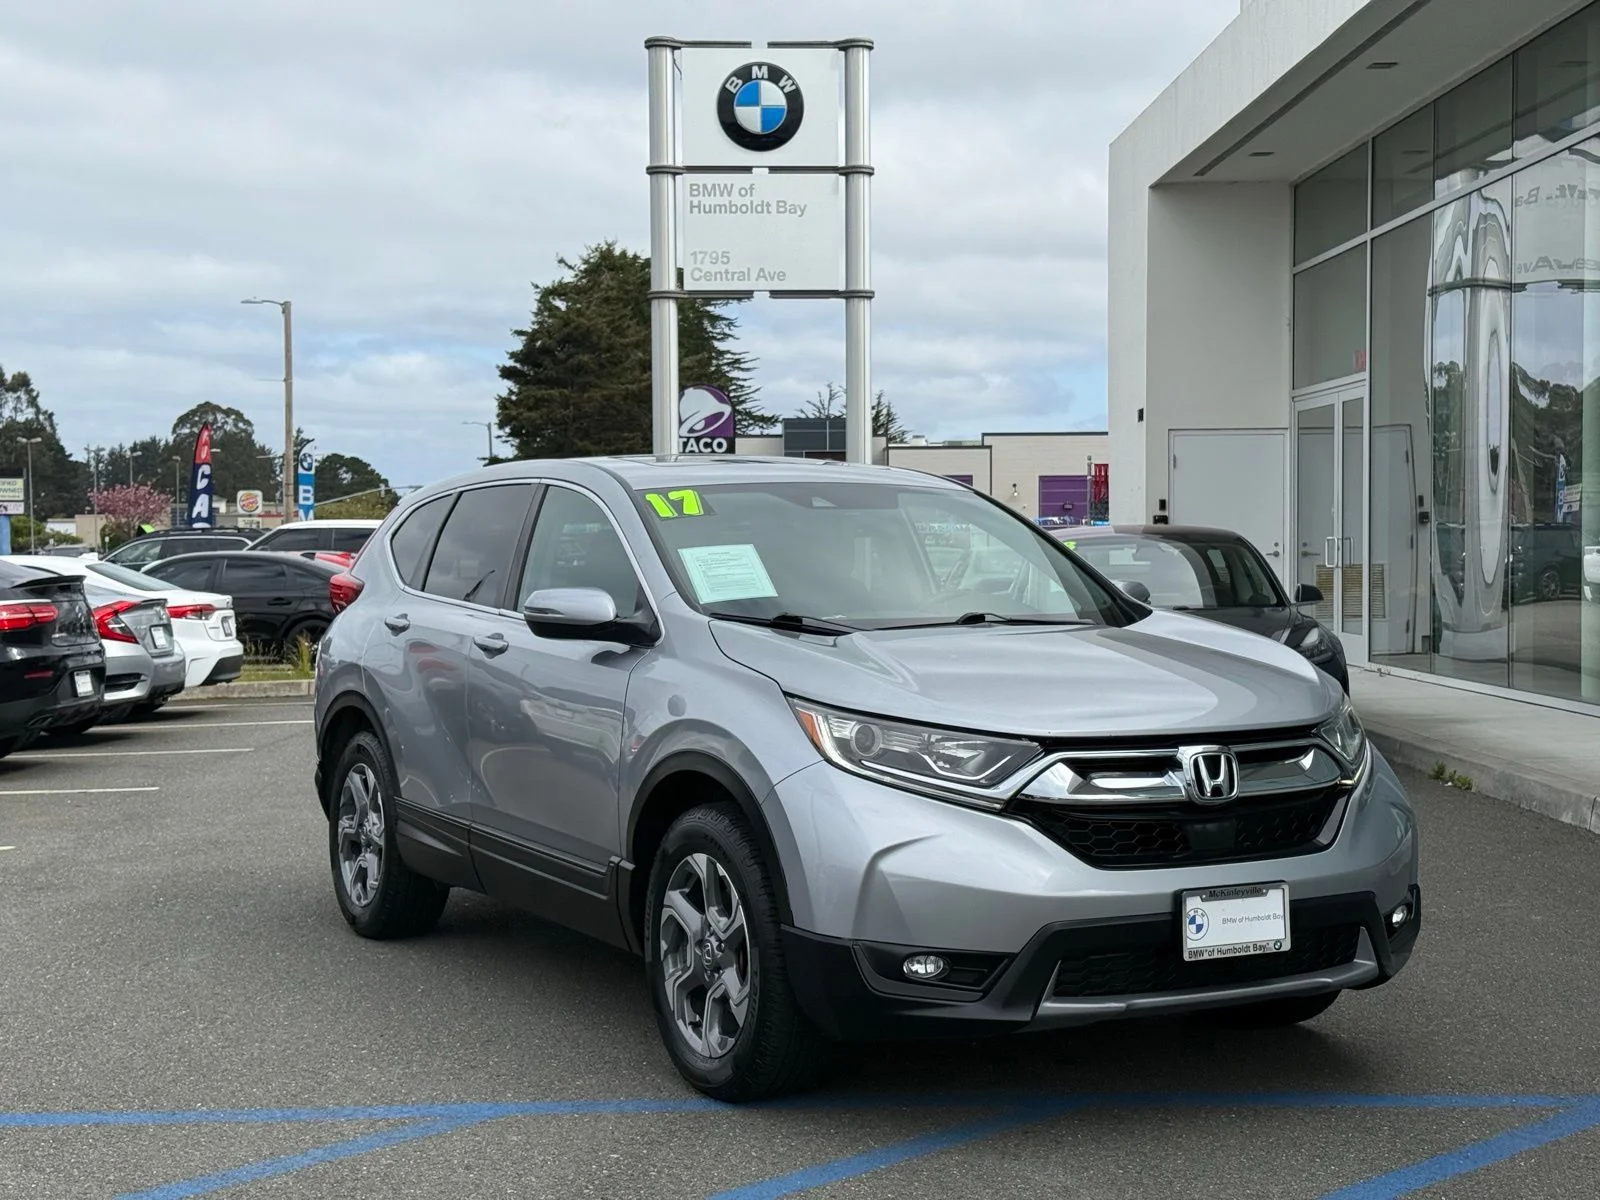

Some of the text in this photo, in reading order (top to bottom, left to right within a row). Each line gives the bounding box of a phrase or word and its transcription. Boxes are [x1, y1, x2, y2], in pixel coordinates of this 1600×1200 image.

[725, 65, 796, 94] BMW
[689, 183, 755, 197] BMW of
[689, 201, 807, 217] Humboldt Bay
[690, 251, 731, 265] 1795
[690, 267, 786, 282] Central Ave
[678, 437, 728, 453] TACO
[191, 464, 212, 528] CA
[645, 489, 705, 518] 17
[1208, 887, 1262, 898] McKinleyville
[1222, 912, 1284, 925] BMW of Humboldt Bay
[1208, 948, 1215, 957] of
[1217, 945, 1251, 956] Humboldt
[1253, 943, 1266, 953] Bay
